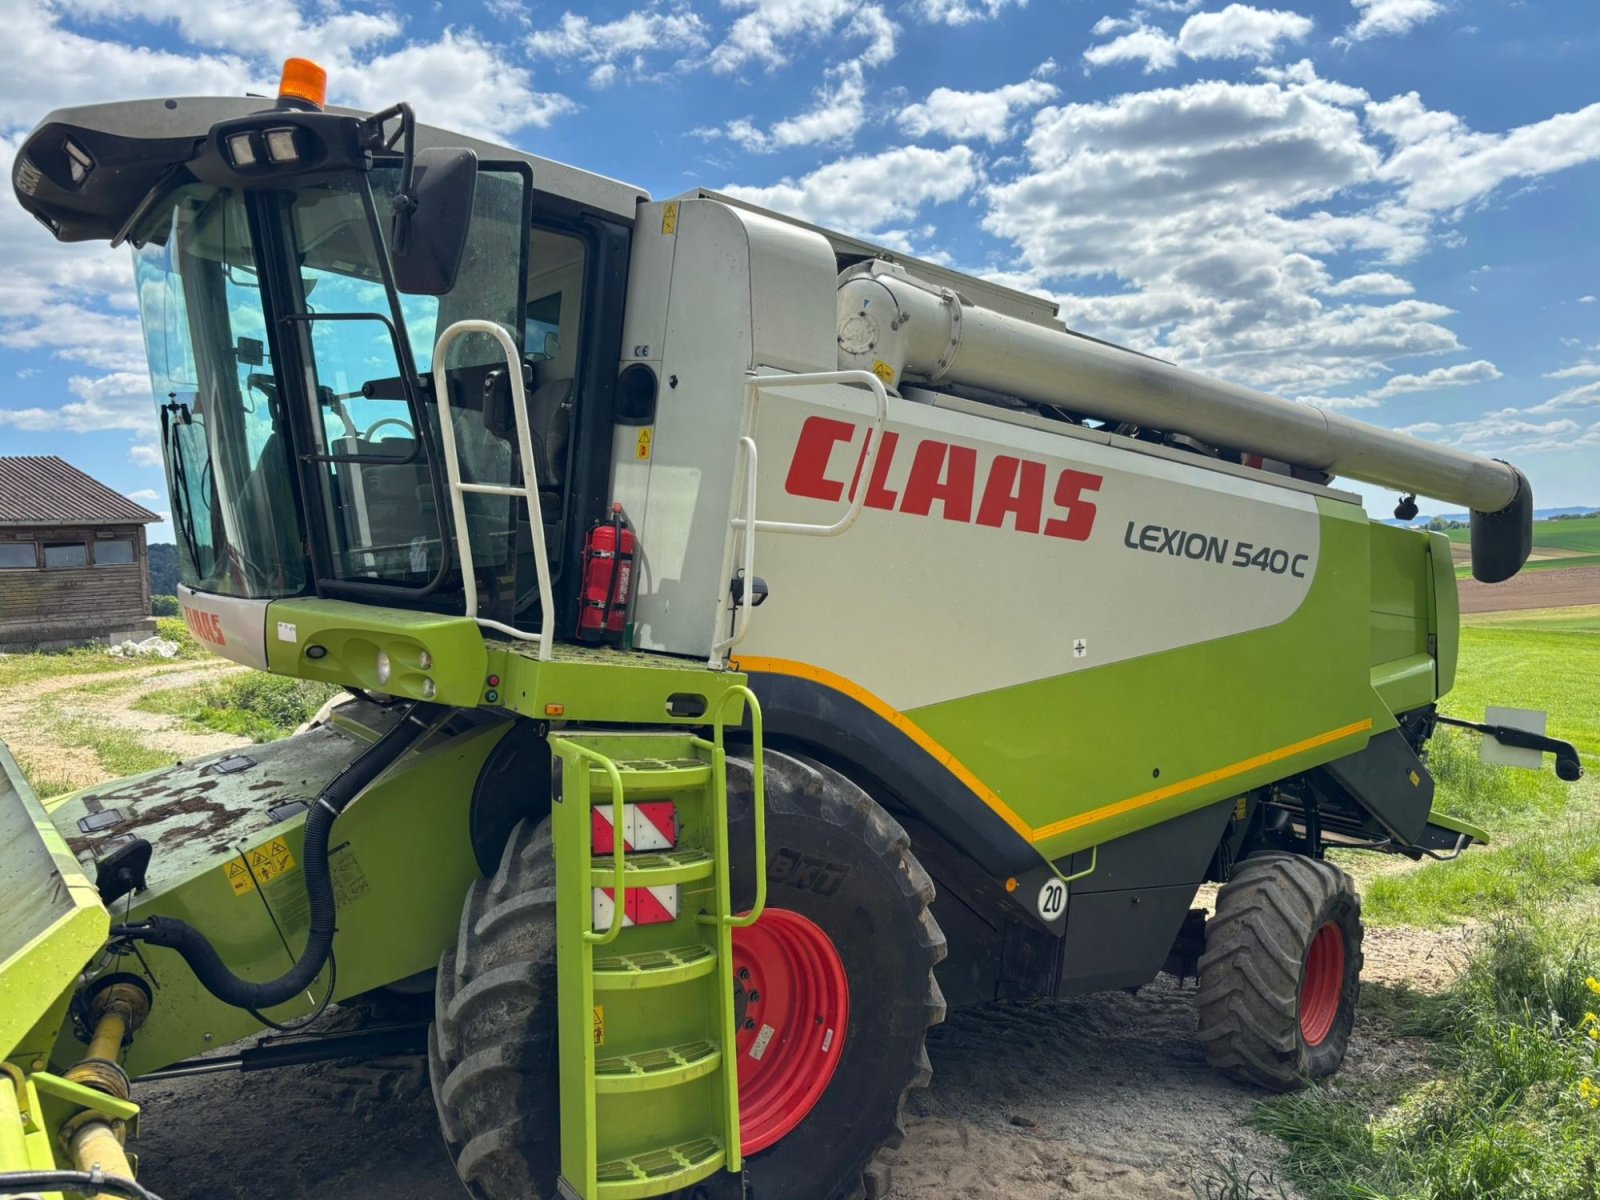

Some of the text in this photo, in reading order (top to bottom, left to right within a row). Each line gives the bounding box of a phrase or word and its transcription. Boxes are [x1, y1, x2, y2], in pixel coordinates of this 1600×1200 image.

[634, 345, 649, 357] CE
[785, 416, 1104, 541] CLAAS
[1124, 521, 1309, 578] LEXION 540 C
[1043, 885, 1062, 913] 20
